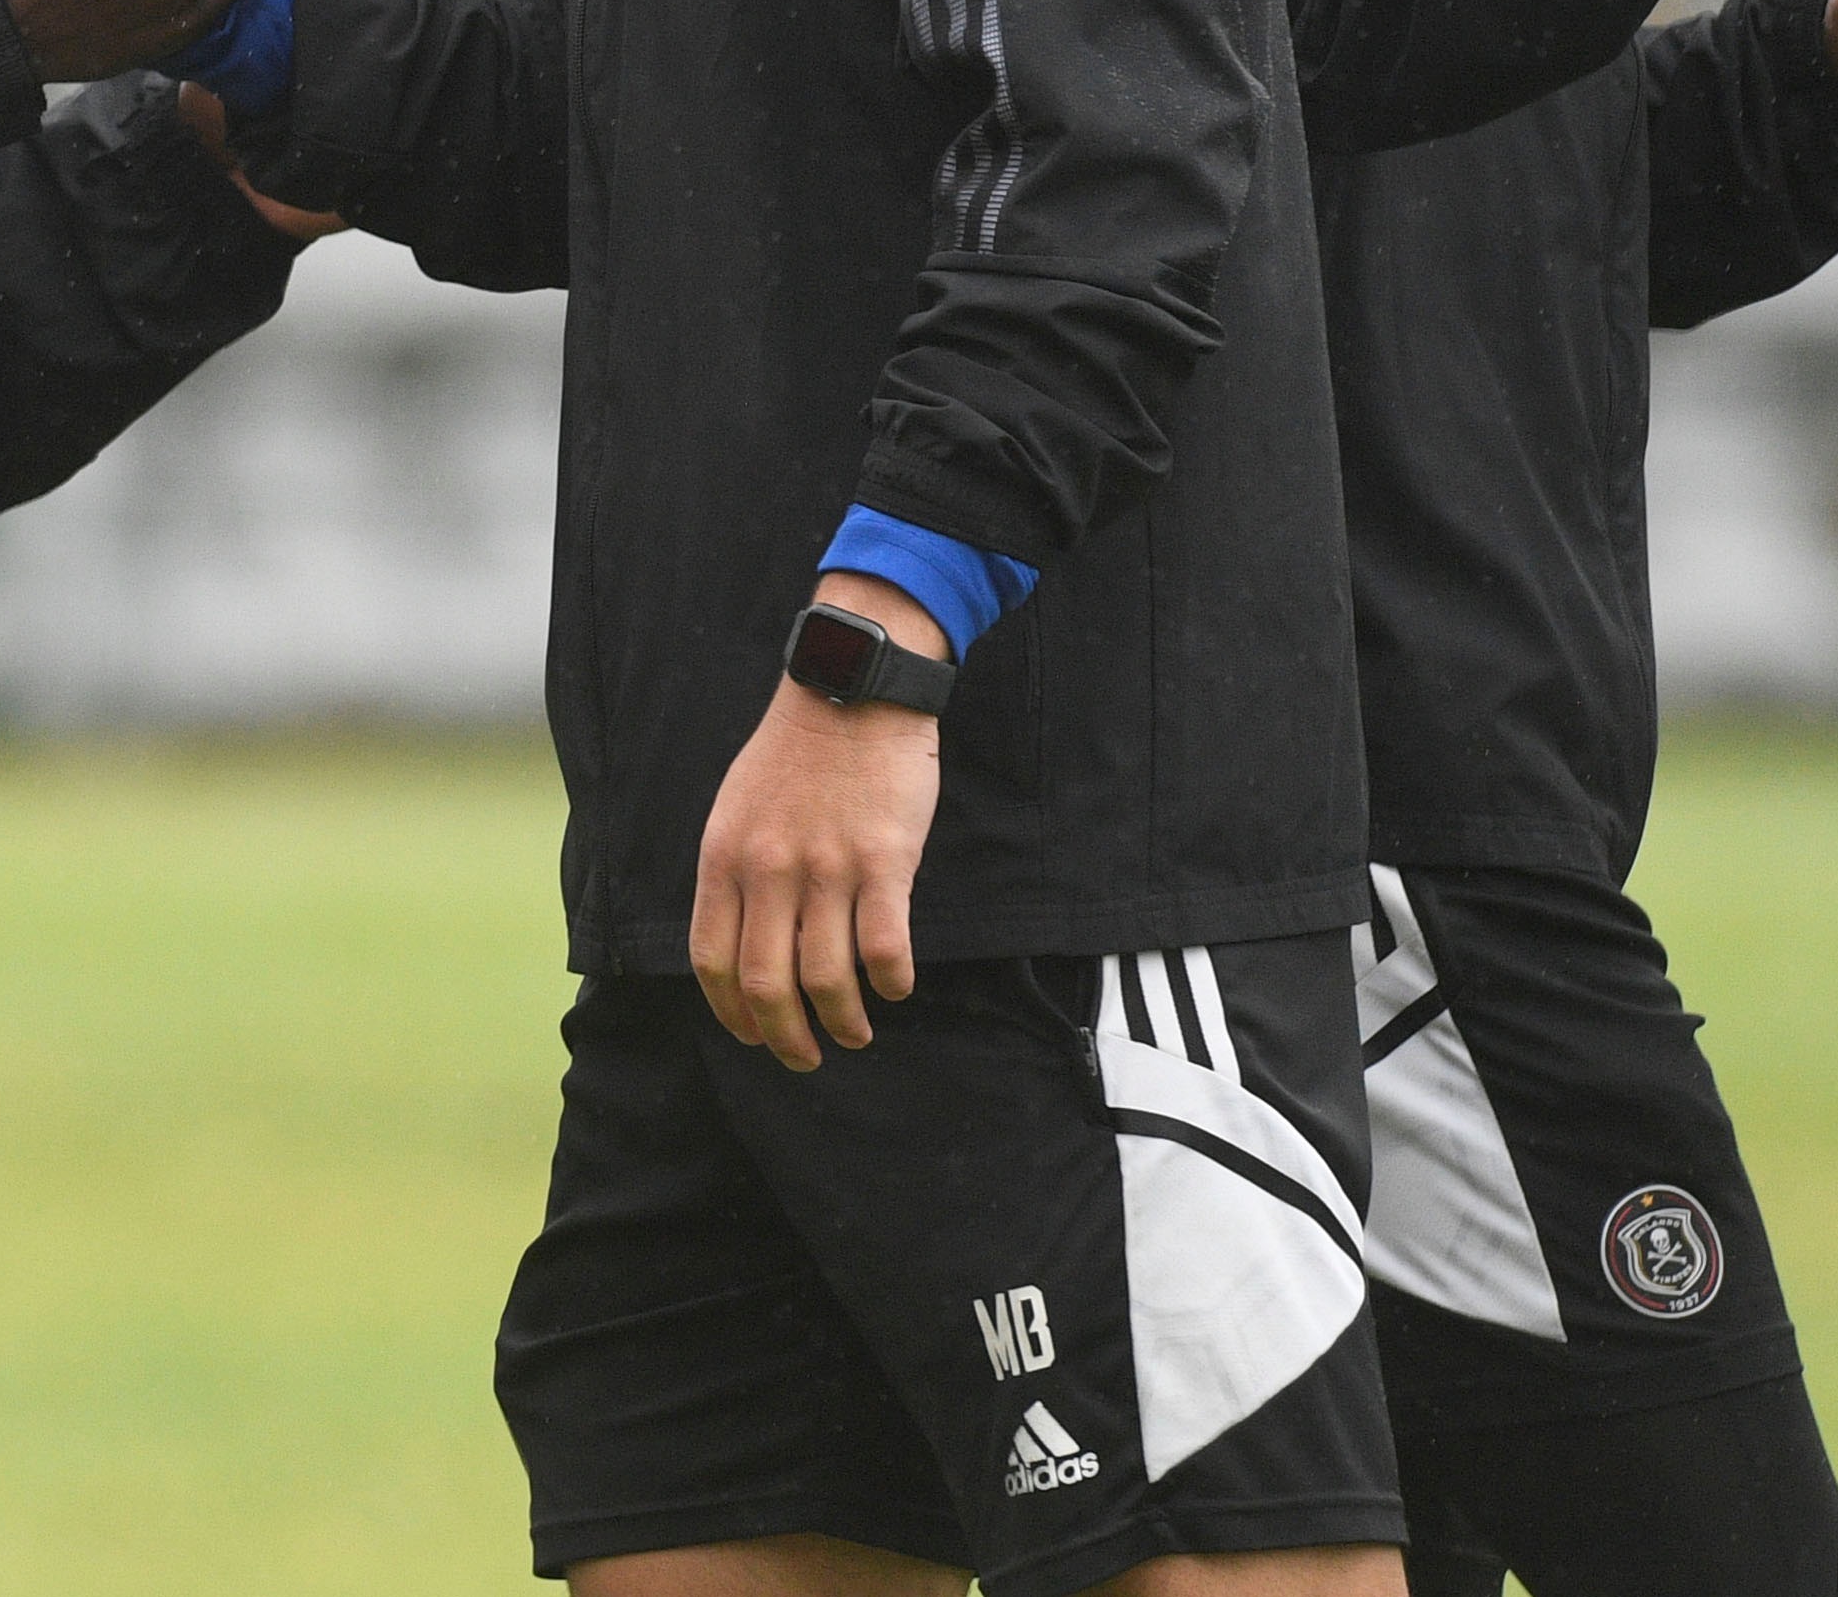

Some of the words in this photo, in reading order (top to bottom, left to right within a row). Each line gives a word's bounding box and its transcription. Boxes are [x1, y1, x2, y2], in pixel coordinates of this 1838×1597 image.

[1669, 1292, 1699, 1311] 1937
[973, 1285, 1055, 1381] MB
[1005, 1452, 1100, 1497] adidas
